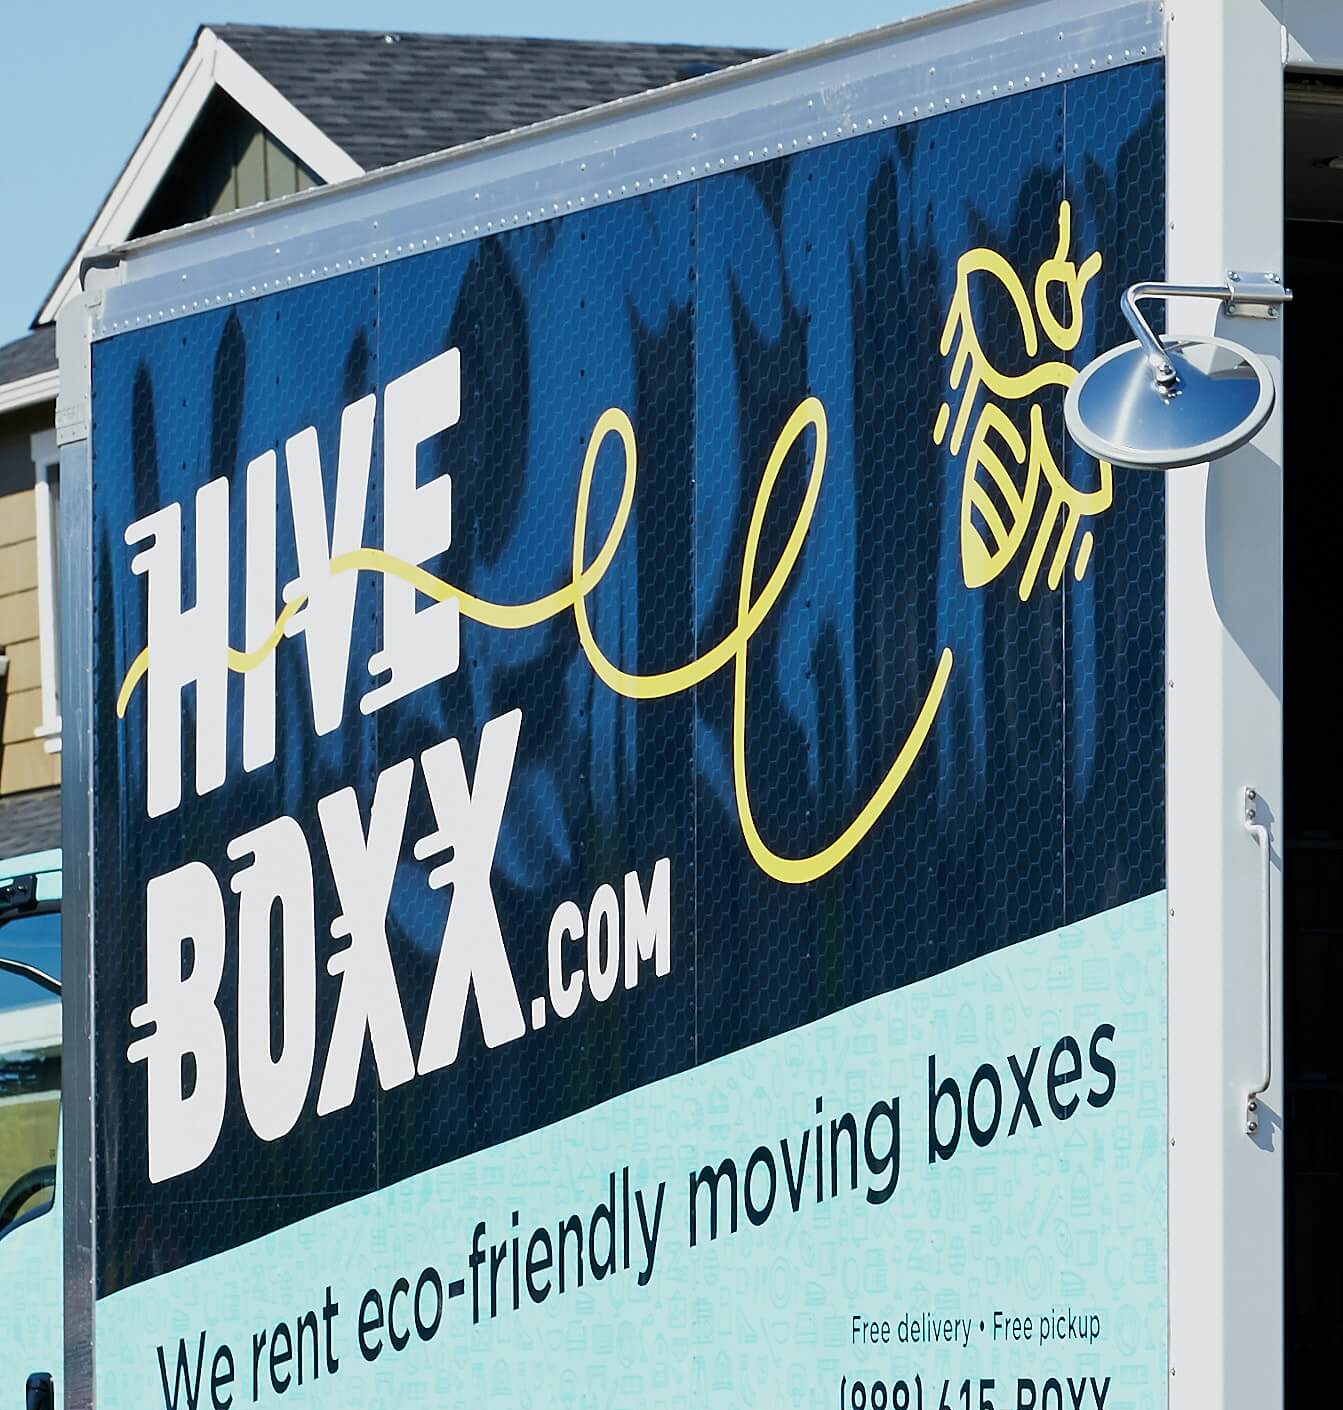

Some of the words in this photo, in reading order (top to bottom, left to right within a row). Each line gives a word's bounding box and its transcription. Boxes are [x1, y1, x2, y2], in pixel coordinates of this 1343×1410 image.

[124, 346, 462, 819] HIVE
[253, 1285, 340, 1403] rent
[358, 1165, 668, 1362] eco-friendly
[689, 1095, 901, 1248] moving
[928, 1022, 1117, 1165] boxes
[852, 1315, 891, 1345] Free
[898, 1312, 972, 1348] delivery
[993, 1311, 1033, 1341] Free
[1040, 1308, 1101, 1346] pickup
